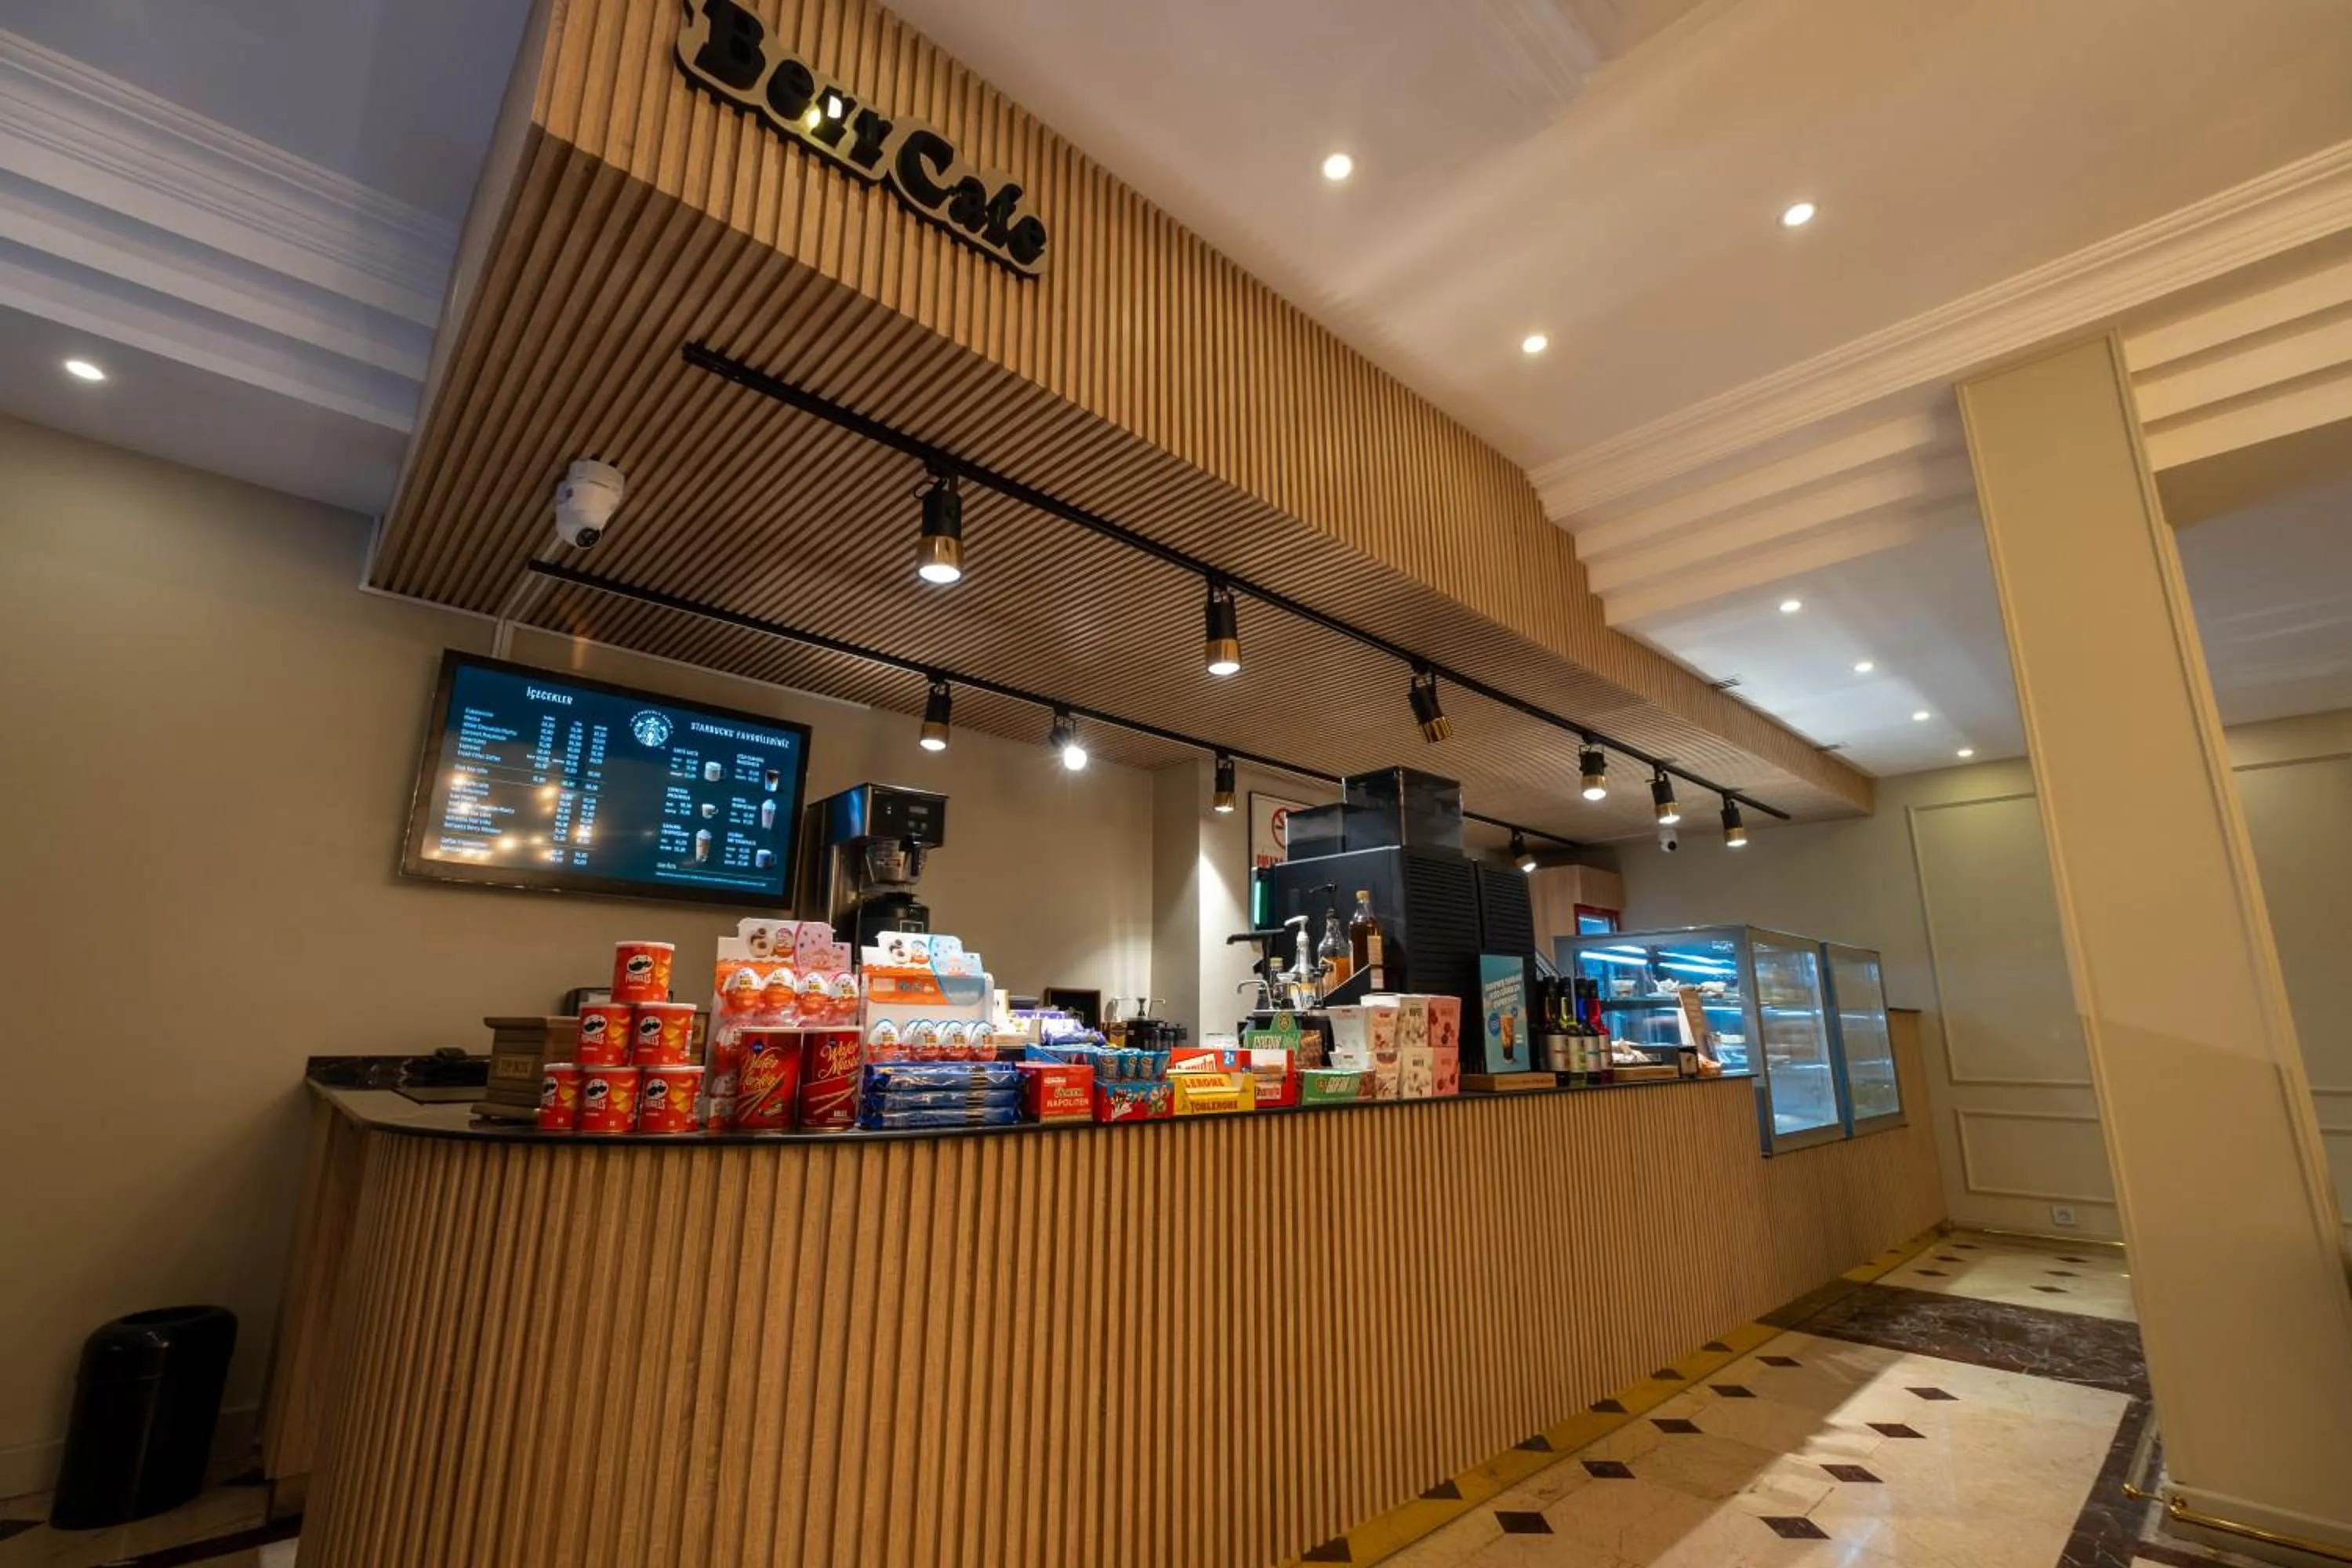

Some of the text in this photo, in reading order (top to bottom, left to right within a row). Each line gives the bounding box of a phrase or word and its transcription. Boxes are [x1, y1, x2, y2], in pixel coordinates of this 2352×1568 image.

[895, 130, 1047, 266] Cafe
[1184, 1077, 1225, 1089] LERONE
[1189, 1100, 1239, 1113] TOBLERONE
